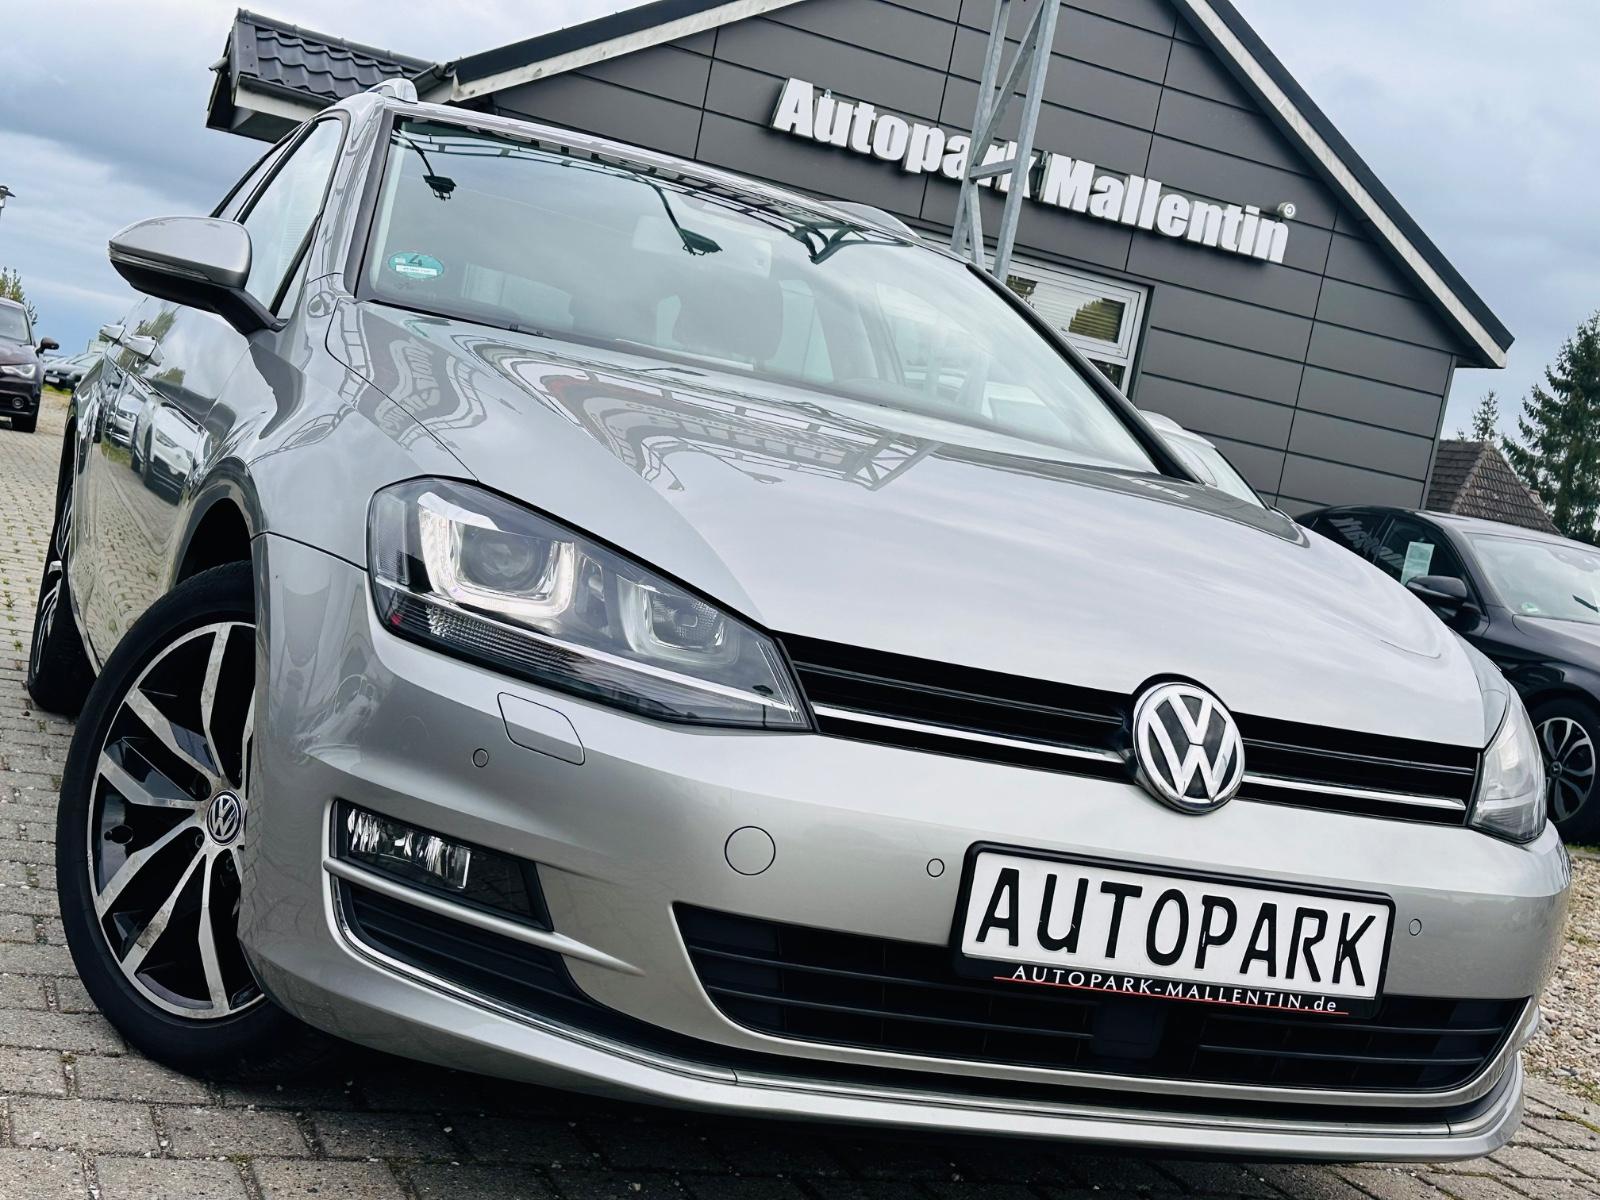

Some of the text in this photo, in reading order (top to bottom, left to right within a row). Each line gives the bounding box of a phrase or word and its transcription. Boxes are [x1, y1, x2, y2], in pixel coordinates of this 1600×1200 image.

[1041, 152, 1289, 263] Mallentin
[975, 867, 1377, 987] AUTOPARK
[1011, 964, 1337, 1013] AUTOPARK-MALLENTIN.de
